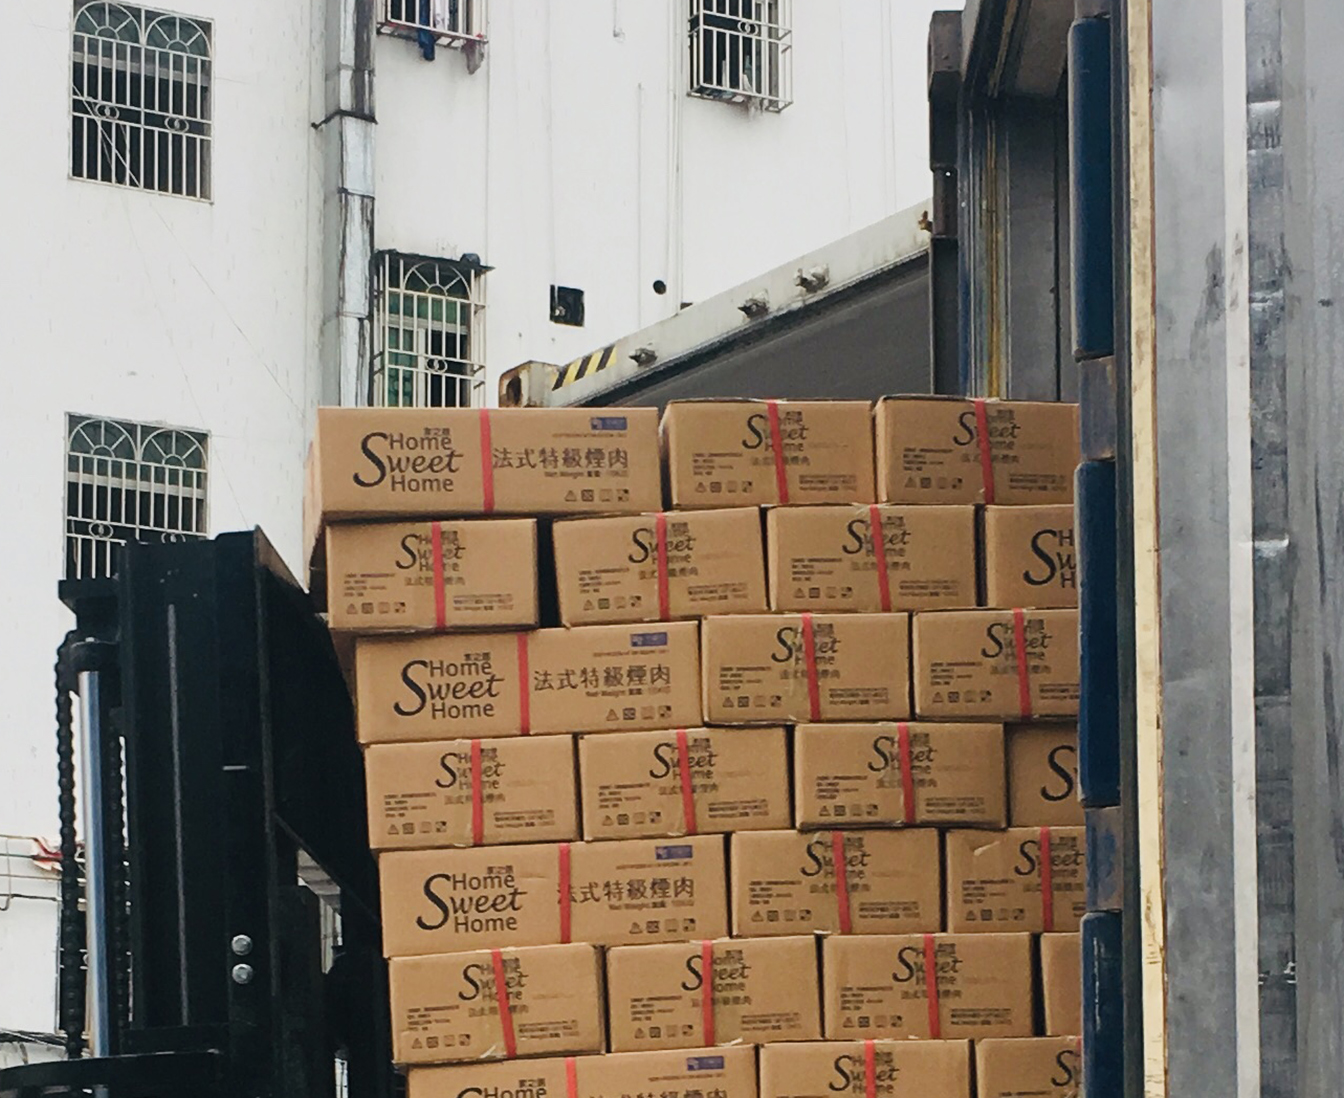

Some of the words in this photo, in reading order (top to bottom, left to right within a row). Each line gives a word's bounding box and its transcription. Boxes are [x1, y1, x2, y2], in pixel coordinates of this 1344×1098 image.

[742, 414, 809, 449] Swet
[953, 411, 1021, 446] Seet
[389, 432, 452, 450] Home
[764, 442, 804, 451] Hme
[353, 431, 464, 488] Sweet
[391, 476, 454, 492] Home
[842, 519, 911, 554] Swet
[395, 533, 466, 569] Swet
[651, 554, 690, 564] Hme
[865, 547, 905, 557] Hme
[419, 561, 459, 571] Hoe
[771, 627, 841, 662] Swet
[981, 622, 1053, 658] Swet
[794, 655, 835, 665] Hme
[1004, 651, 1045, 661] Hme
[429, 660, 492, 678] Home
[393, 659, 505, 717] Sweet
[431, 703, 495, 719] Home
[868, 736, 937, 771] Swet
[435, 752, 505, 788] Swet
[672, 769, 713, 780] Hme
[890, 764, 931, 774] Hme
[458, 779, 499, 790] Hme
[801, 840, 871, 876] Swet
[1014, 840, 1085, 875] Seet
[452, 873, 515, 891] Home
[824, 868, 865, 879] Hme
[415, 873, 528, 931] Sweet
[455, 916, 518, 933] Home
[681, 955, 751, 991] Seet
[892, 946, 963, 982] Swet
[458, 963, 529, 1000] Swet
[713, 982, 745, 993] ome
[915, 975, 956, 986] Hme
[481, 989, 522, 1002] Hoe
[829, 1055, 899, 1091] Swet
[852, 1083, 894, 1094] Hme
